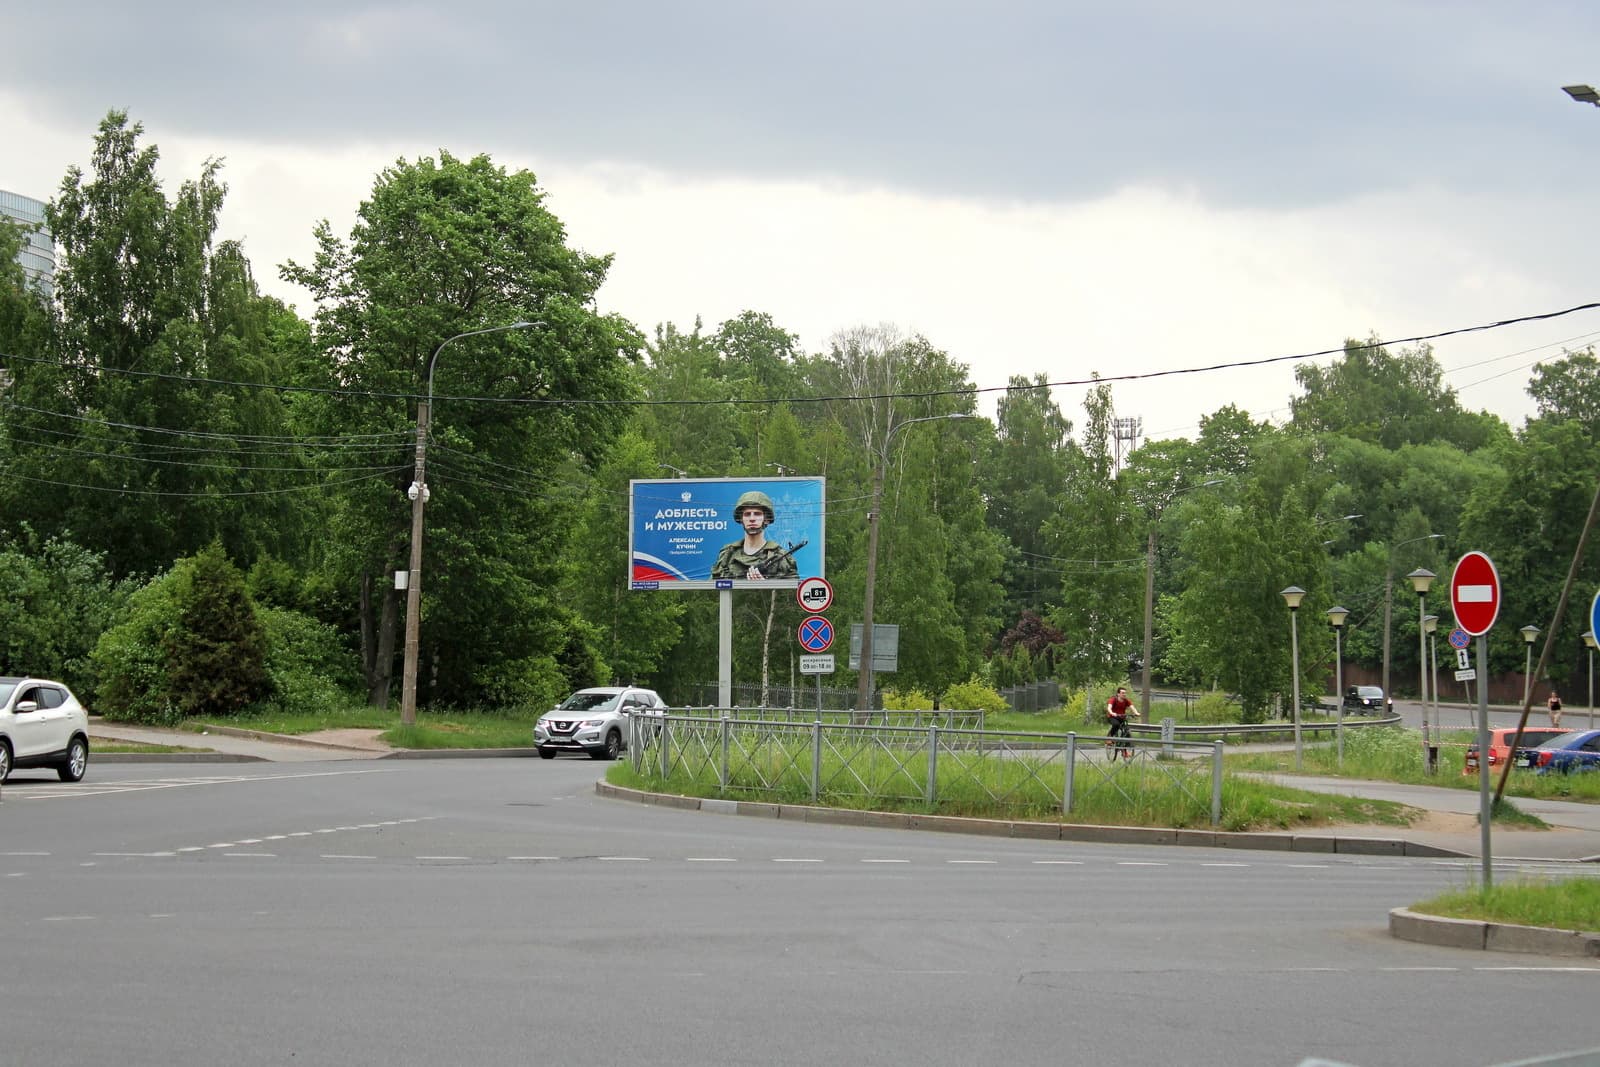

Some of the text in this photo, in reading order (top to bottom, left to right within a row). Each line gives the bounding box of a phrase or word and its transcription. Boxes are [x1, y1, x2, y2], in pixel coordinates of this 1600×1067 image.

[655, 508, 718, 519] ДОБЛЕСТЬ
[645, 521, 728, 531] И МУЖЕСТВО!
